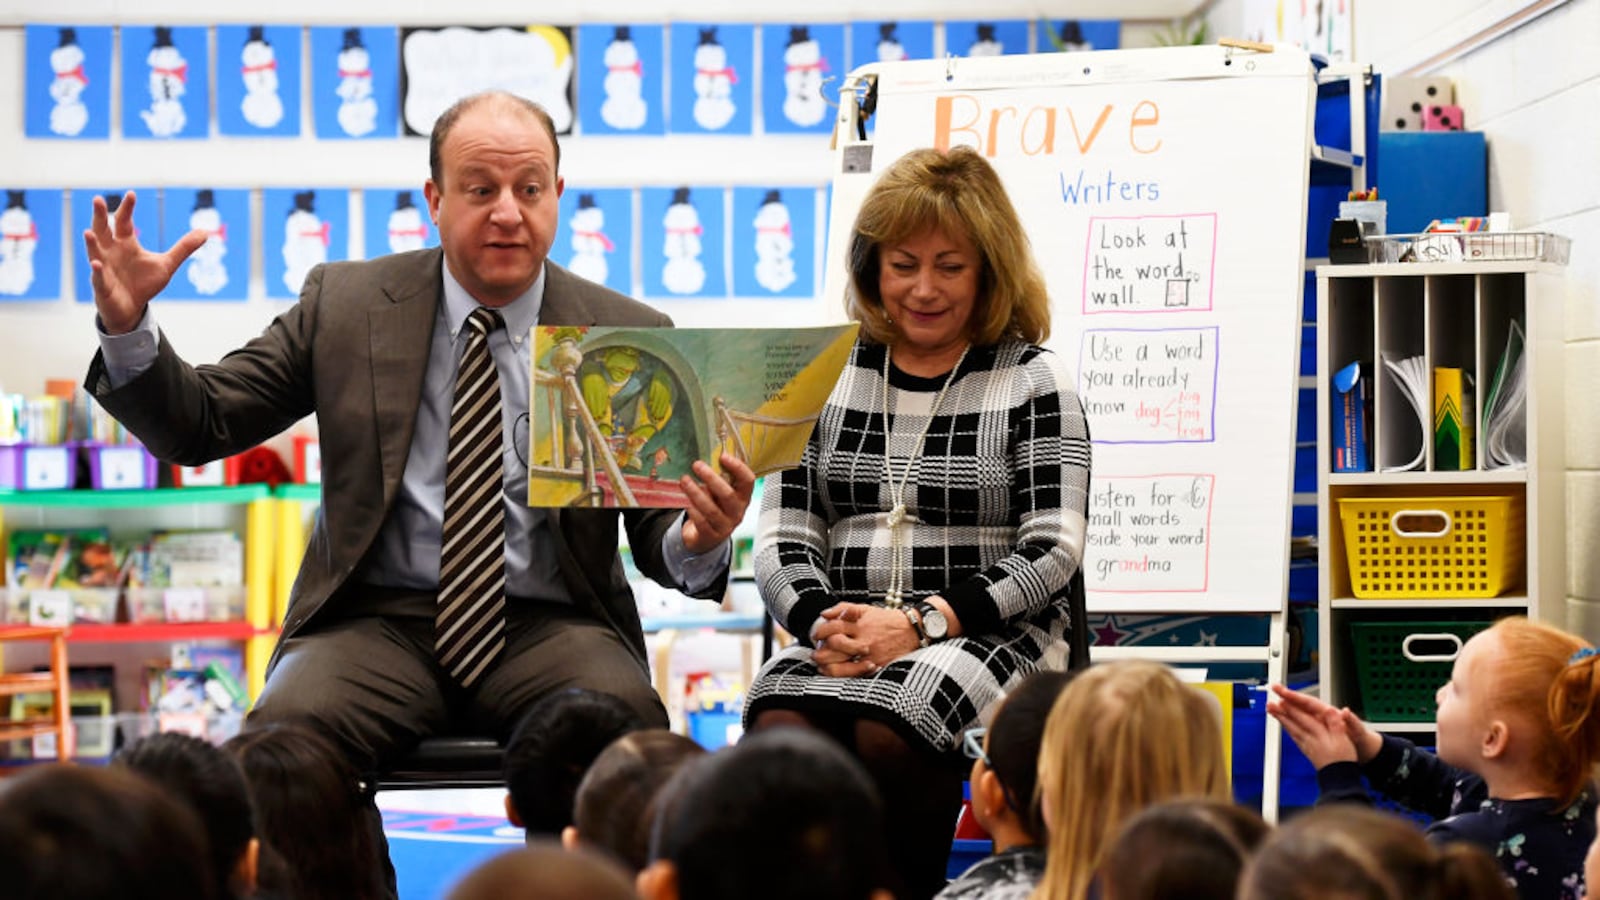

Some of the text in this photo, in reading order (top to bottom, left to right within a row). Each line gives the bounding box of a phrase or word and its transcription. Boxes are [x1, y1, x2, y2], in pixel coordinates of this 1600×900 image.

[934, 95, 1163, 157] Brave
[1060, 169, 1160, 205] Writers
[1101, 219, 1188, 249] Look at
[1092, 252, 1184, 280] the word
[1091, 333, 1204, 362] Use a word
[1083, 366, 1190, 390] you already
[1134, 400, 1161, 428] dog
[1094, 482, 1175, 508] isten for
[1088, 510, 1180, 526] mall words
[1086, 528, 1204, 546] nside your word
[1097, 555, 1171, 581] grandma
